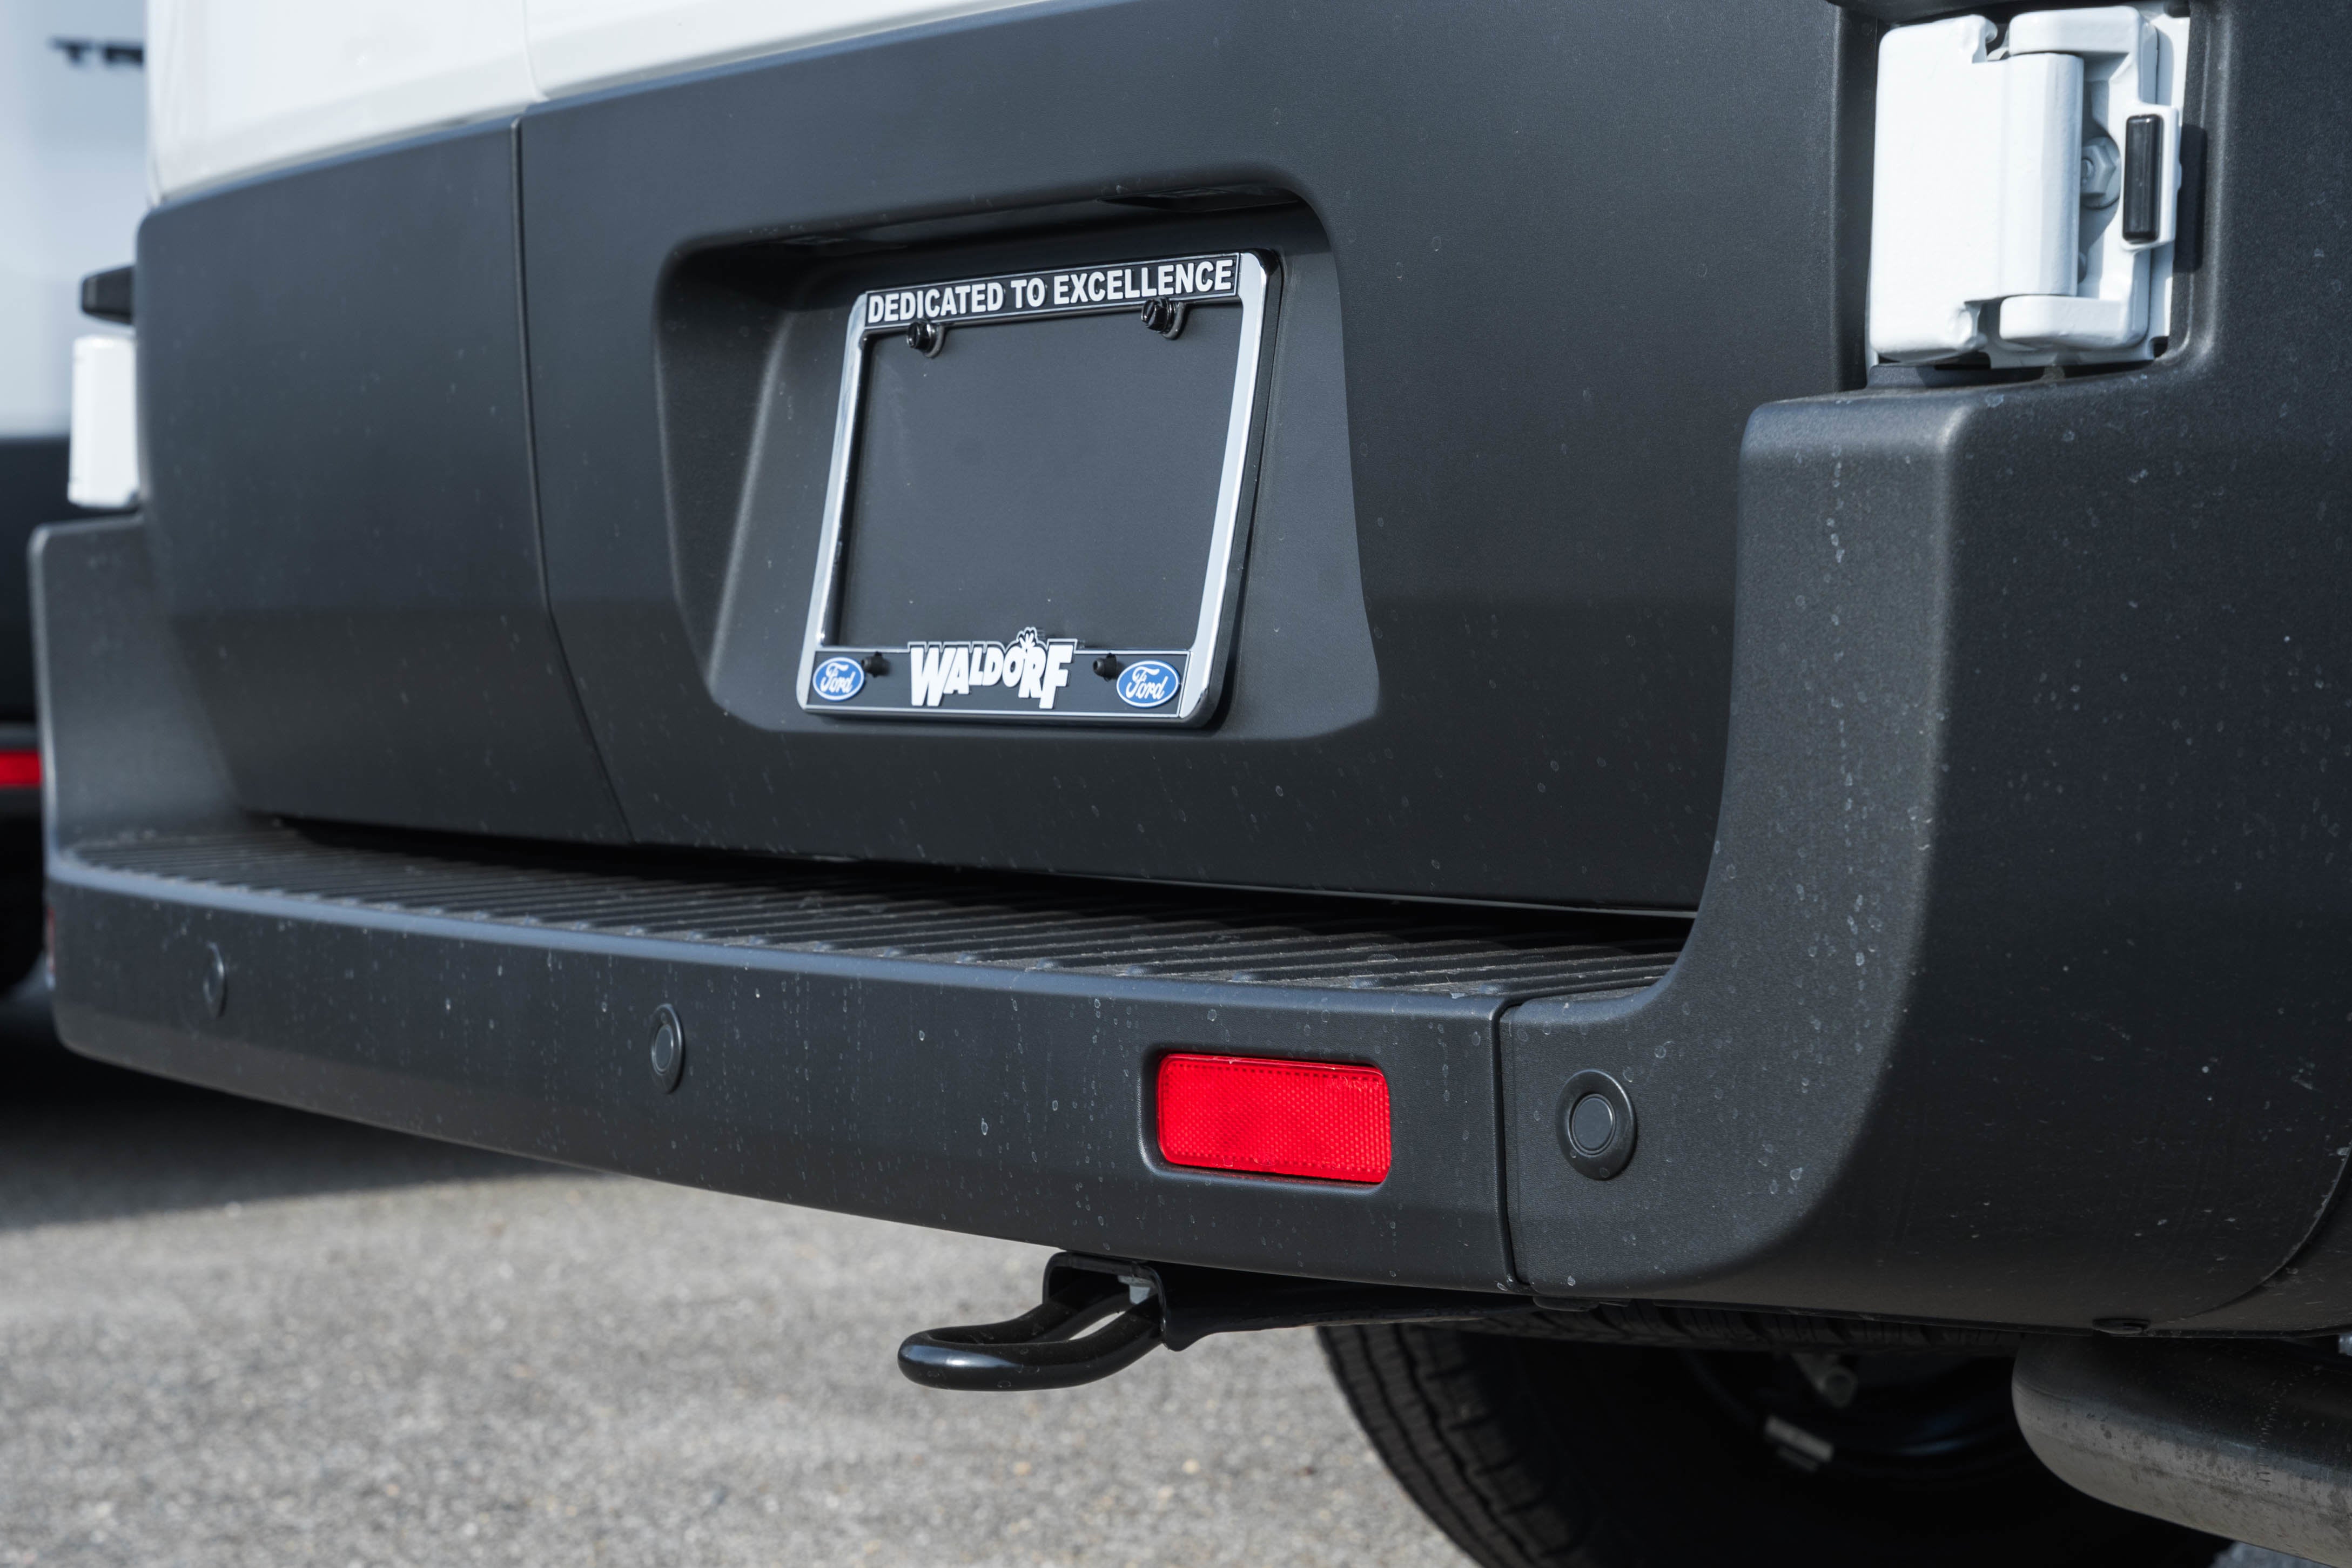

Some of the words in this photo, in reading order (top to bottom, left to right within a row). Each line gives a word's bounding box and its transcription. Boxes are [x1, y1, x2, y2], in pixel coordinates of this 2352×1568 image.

[868, 281, 1004, 324] DEDICATED
[1010, 277, 1046, 308] TO
[1053, 259, 1234, 305] EXCELLENCE
[820, 662, 856, 693] Ford
[910, 644, 1074, 709] WALDORF
[1125, 666, 1168, 699] Ford
